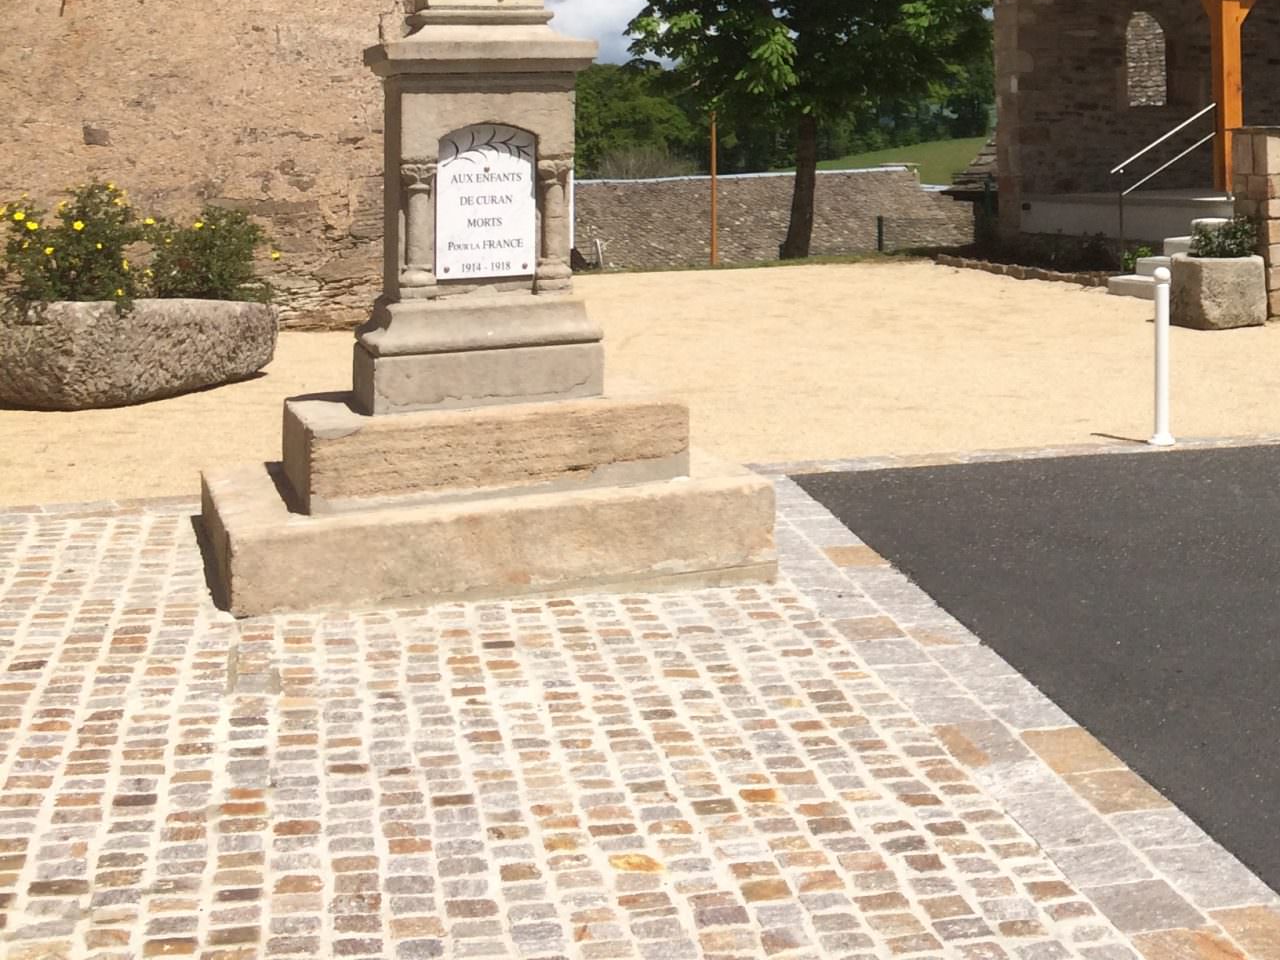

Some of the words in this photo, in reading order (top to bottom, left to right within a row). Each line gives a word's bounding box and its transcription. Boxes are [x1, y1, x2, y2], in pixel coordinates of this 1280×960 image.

[451, 173, 473, 184] AUX
[476, 172, 522, 183] ENFANTS
[459, 195, 474, 206] DE
[476, 194, 513, 205] CURAN
[467, 217, 503, 228] MORTS
[483, 238, 524, 249] FRANCE
[462, 262, 482, 273] 1914
[490, 261, 511, 271] 1918
